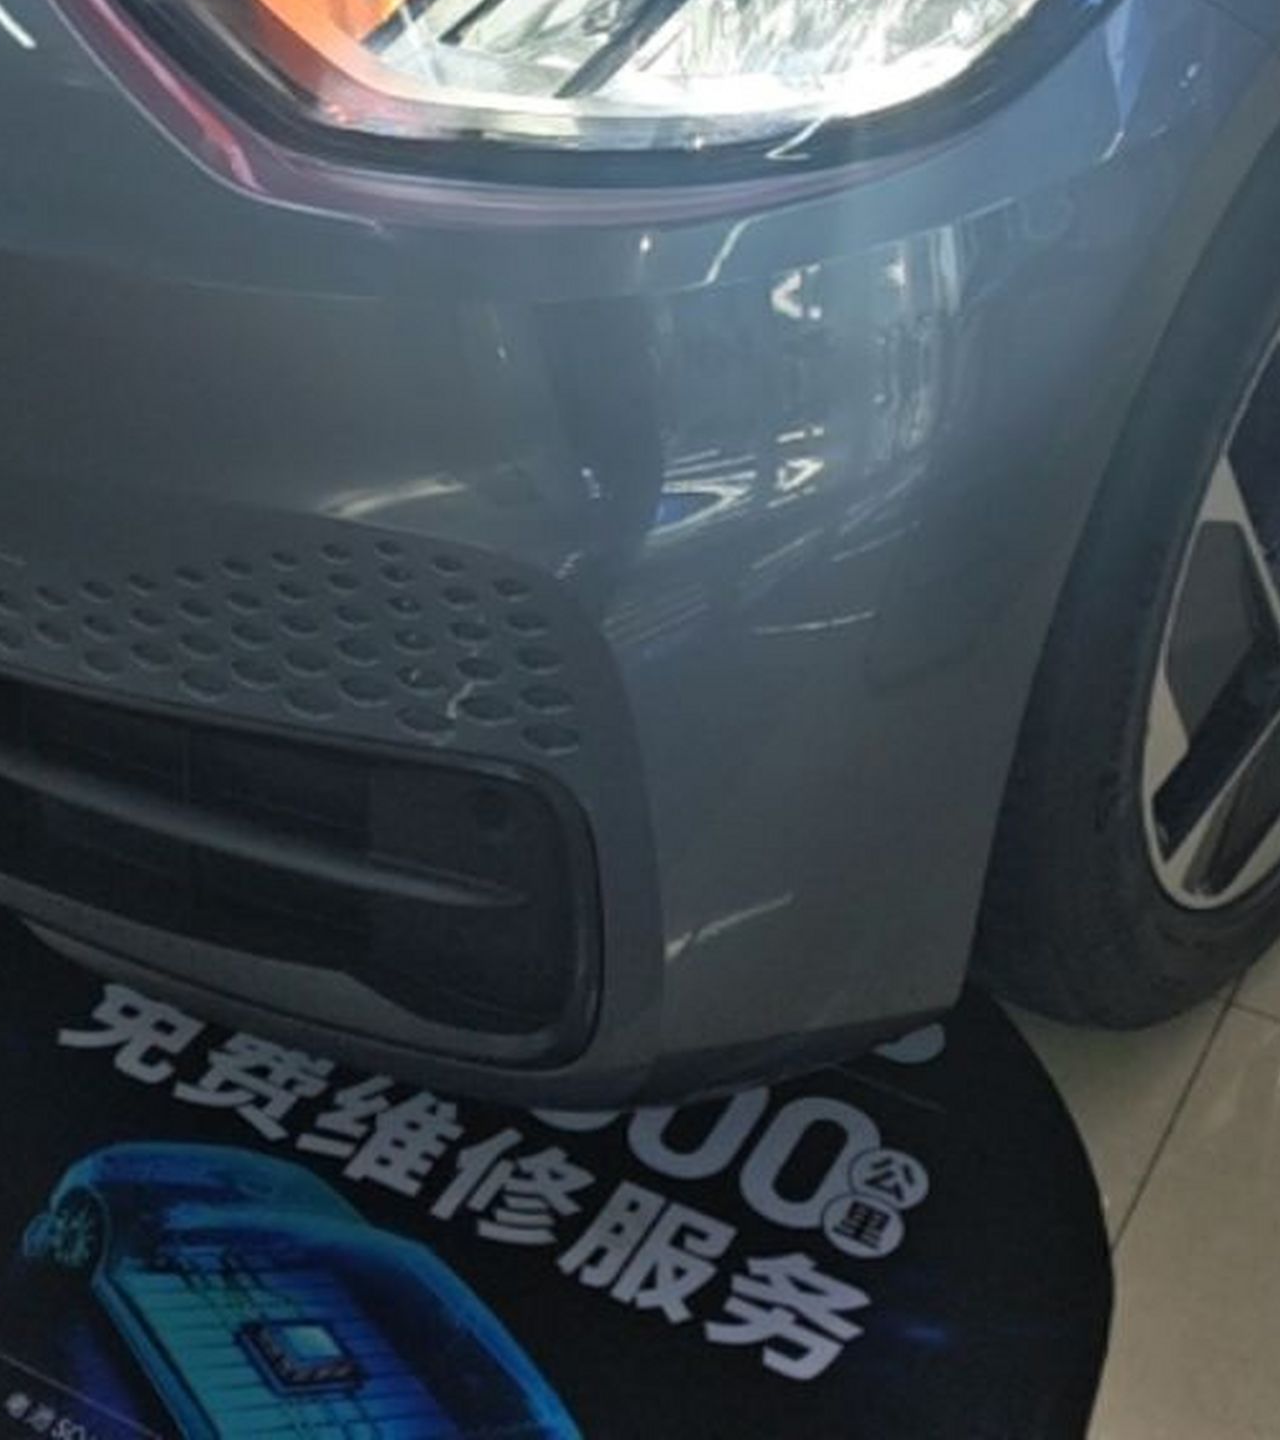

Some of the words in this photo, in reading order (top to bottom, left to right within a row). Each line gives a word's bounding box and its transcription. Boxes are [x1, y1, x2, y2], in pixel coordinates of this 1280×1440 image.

[58, 983, 873, 1381] 免费维修服务
